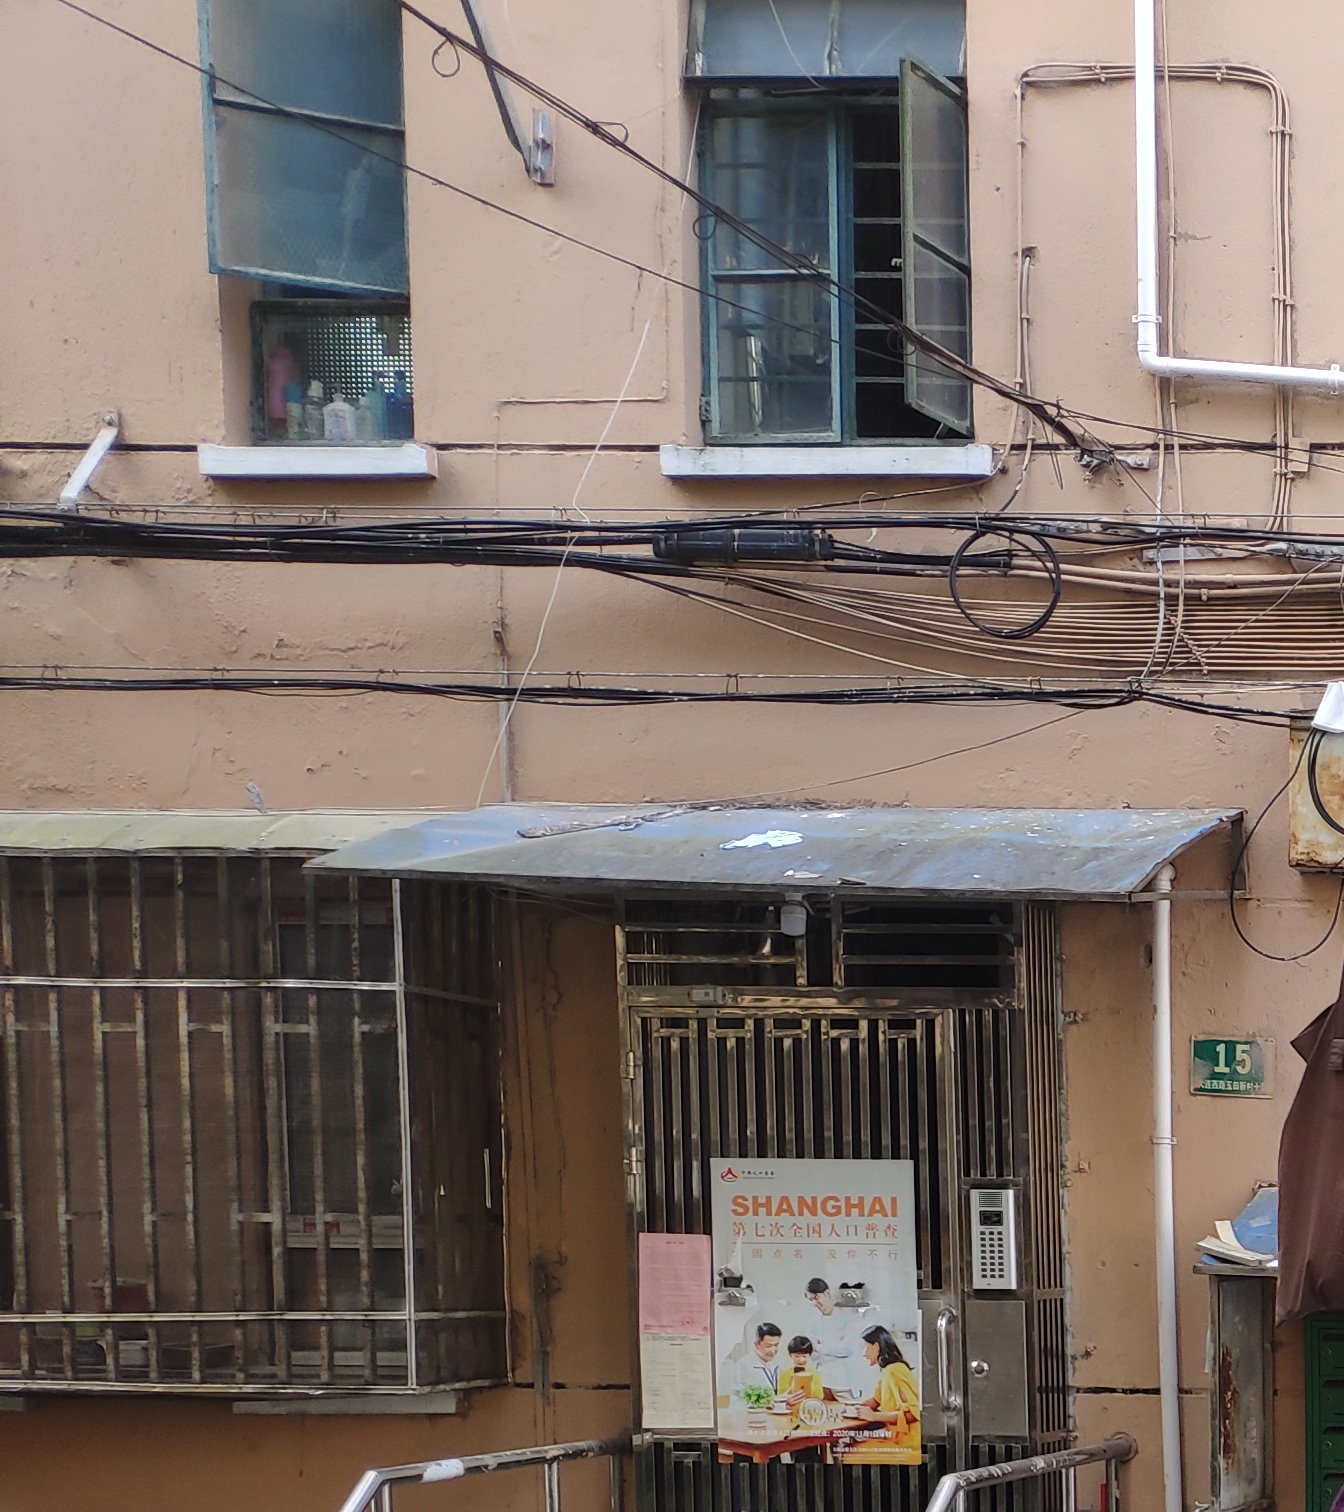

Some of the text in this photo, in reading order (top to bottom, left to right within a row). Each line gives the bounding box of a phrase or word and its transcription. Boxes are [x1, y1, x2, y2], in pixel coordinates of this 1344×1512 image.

[1214, 1043, 1251, 1074] 15
[731, 1195, 898, 1218] SHANGHAI
[732, 1221, 898, 1239] 第七次全国人口普查
[827, 1248, 898, 1260] 没你不行
